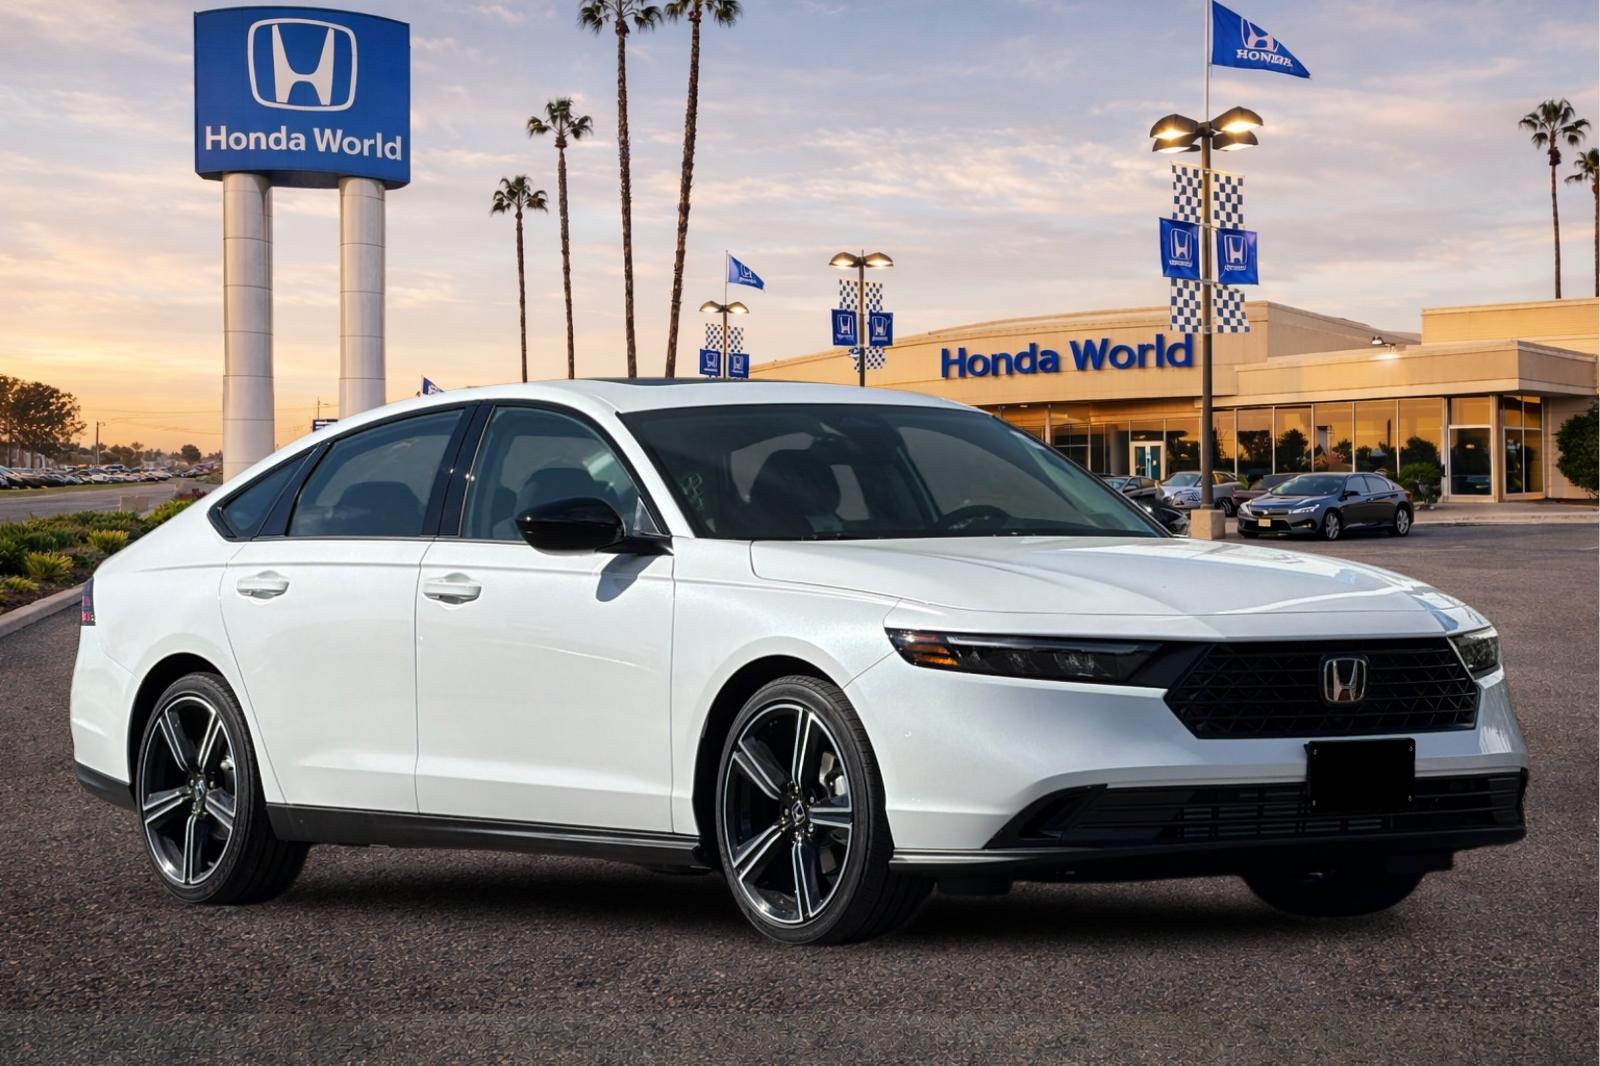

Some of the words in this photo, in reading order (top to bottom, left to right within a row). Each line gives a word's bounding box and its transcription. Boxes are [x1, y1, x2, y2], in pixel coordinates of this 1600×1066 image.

[205, 125, 306, 151] Honda
[312, 127, 403, 161] World
[941, 342, 1061, 379] Honda
[1069, 333, 1194, 371] World
